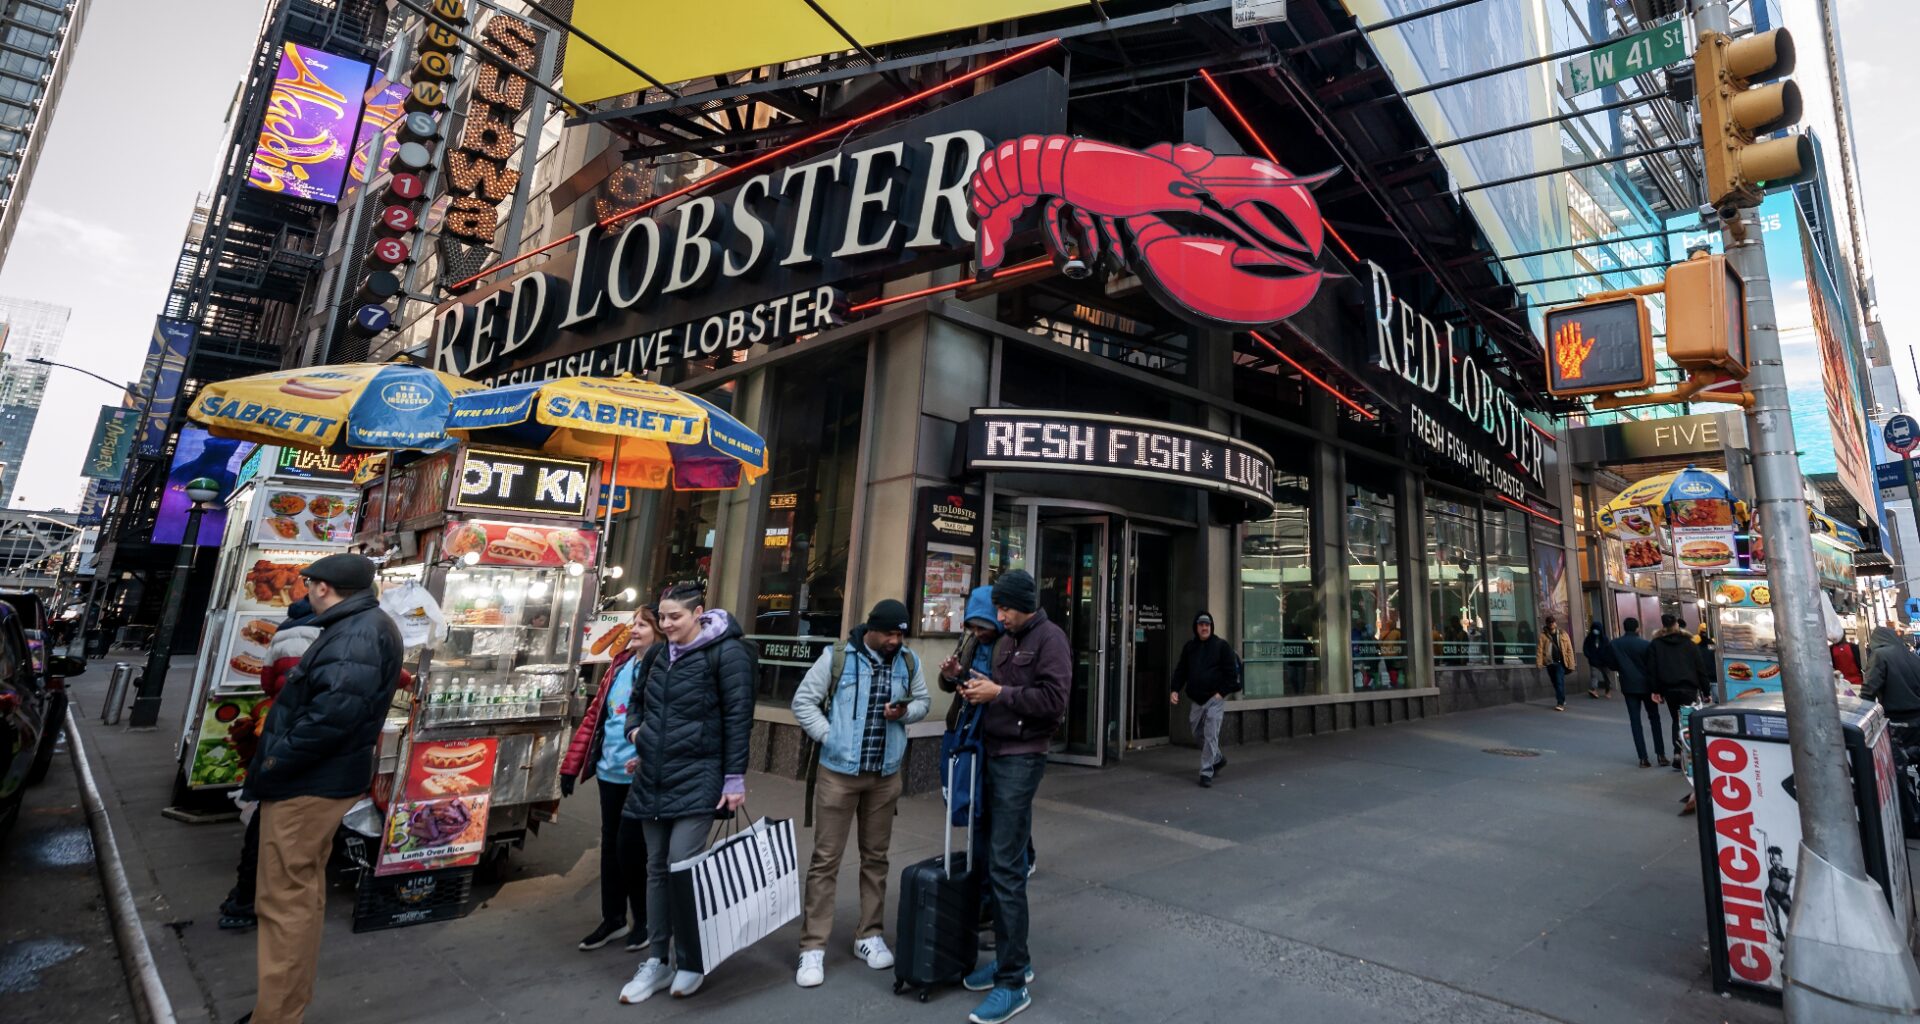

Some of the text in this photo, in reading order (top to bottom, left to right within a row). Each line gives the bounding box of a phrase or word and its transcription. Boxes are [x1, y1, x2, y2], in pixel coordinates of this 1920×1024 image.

[434, 21, 452, 44] R
[427, 56, 446, 74] Q
[1592, 27, 1682, 82] W 41 St
[419, 88, 439, 102] W
[416, 117, 431, 134] S
[400, 178, 412, 194] 1
[391, 210, 407, 229] 2
[383, 241, 401, 260] 3
[433, 130, 991, 376] RED LOBSTER
[367, 308, 384, 326] 7
[613, 329, 674, 375] LIVE
[683, 285, 836, 359] LOBSTER
[1367, 258, 1545, 489] RED LOBSTER
[199, 396, 337, 437] SABRETT
[549, 397, 699, 435] SABRETT
[1655, 421, 1720, 447] FIVE
[1108, 428, 1192, 472] FISH
[1224, 447, 1264, 491] LIVE
[1411, 403, 1525, 503] FRESH FISH LIVE LOBSTER
[932, 504, 948, 513] RED
[948, 504, 977, 519] LOBSTER
[765, 644, 811, 658] FRESH FISH
[401, 845, 465, 860] Lamb Over Rice
[1706, 738, 1771, 983] CHICAGO
